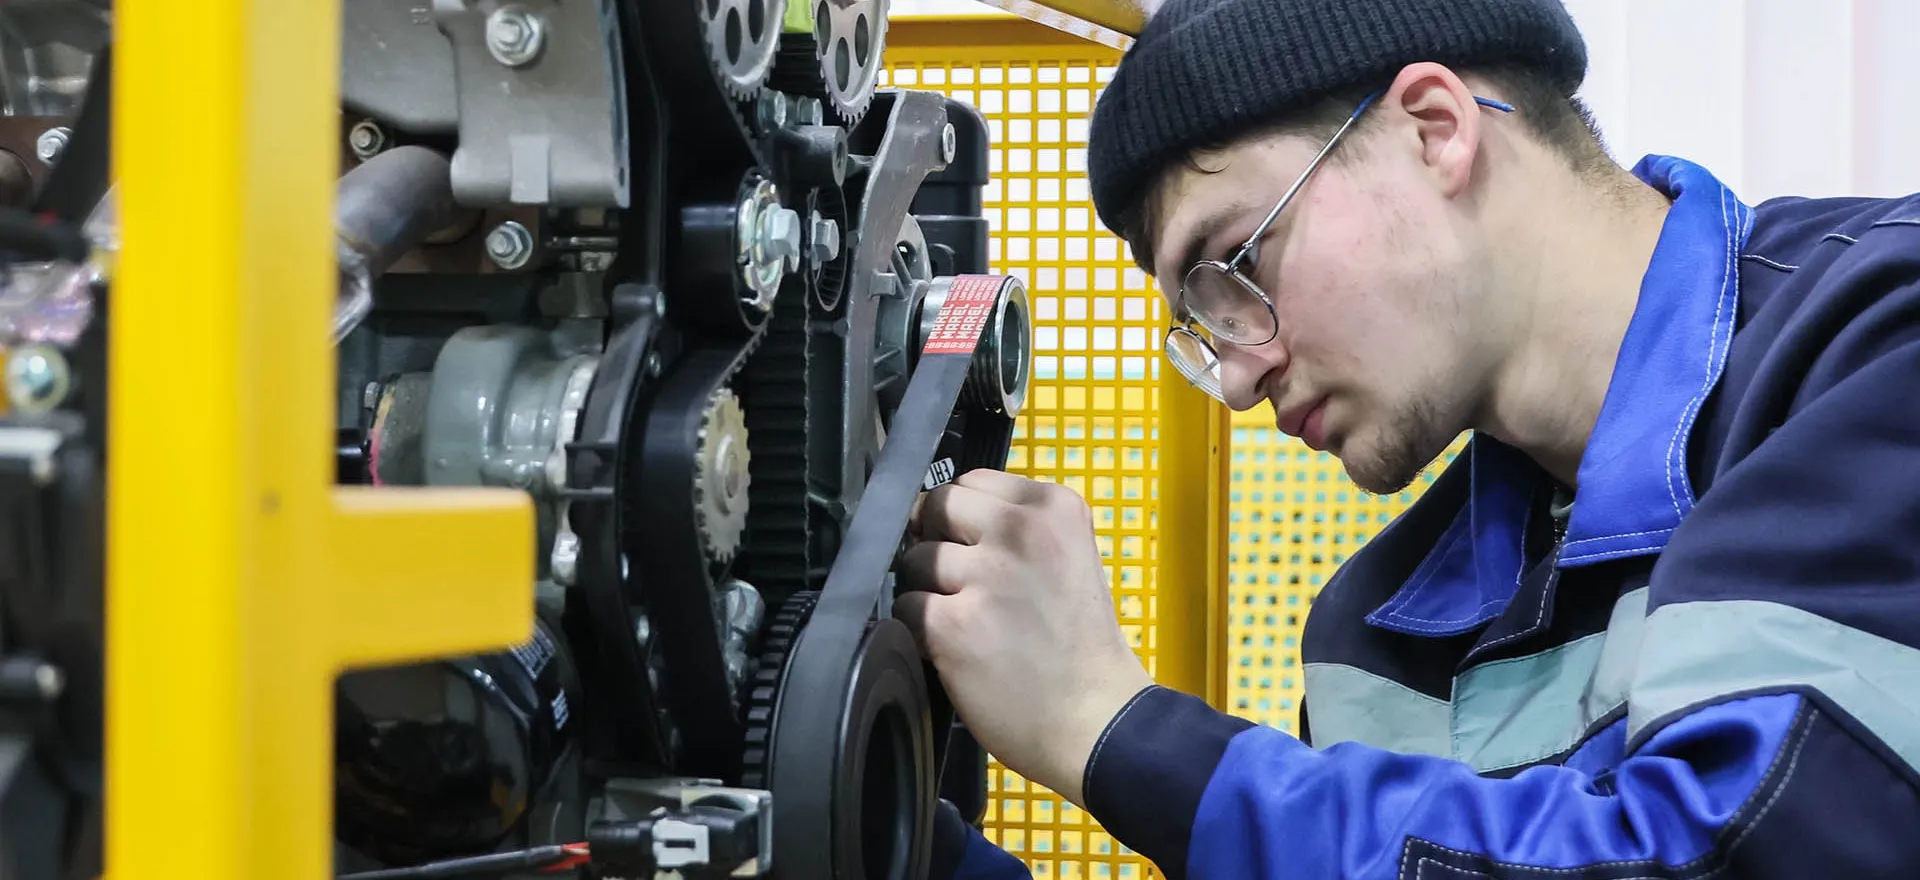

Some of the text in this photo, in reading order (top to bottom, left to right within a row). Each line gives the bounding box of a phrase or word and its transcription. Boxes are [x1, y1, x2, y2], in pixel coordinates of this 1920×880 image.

[928, 303, 955, 340] MAREL
[940, 302, 970, 339] MAREL
[955, 303, 985, 339] MAREL
